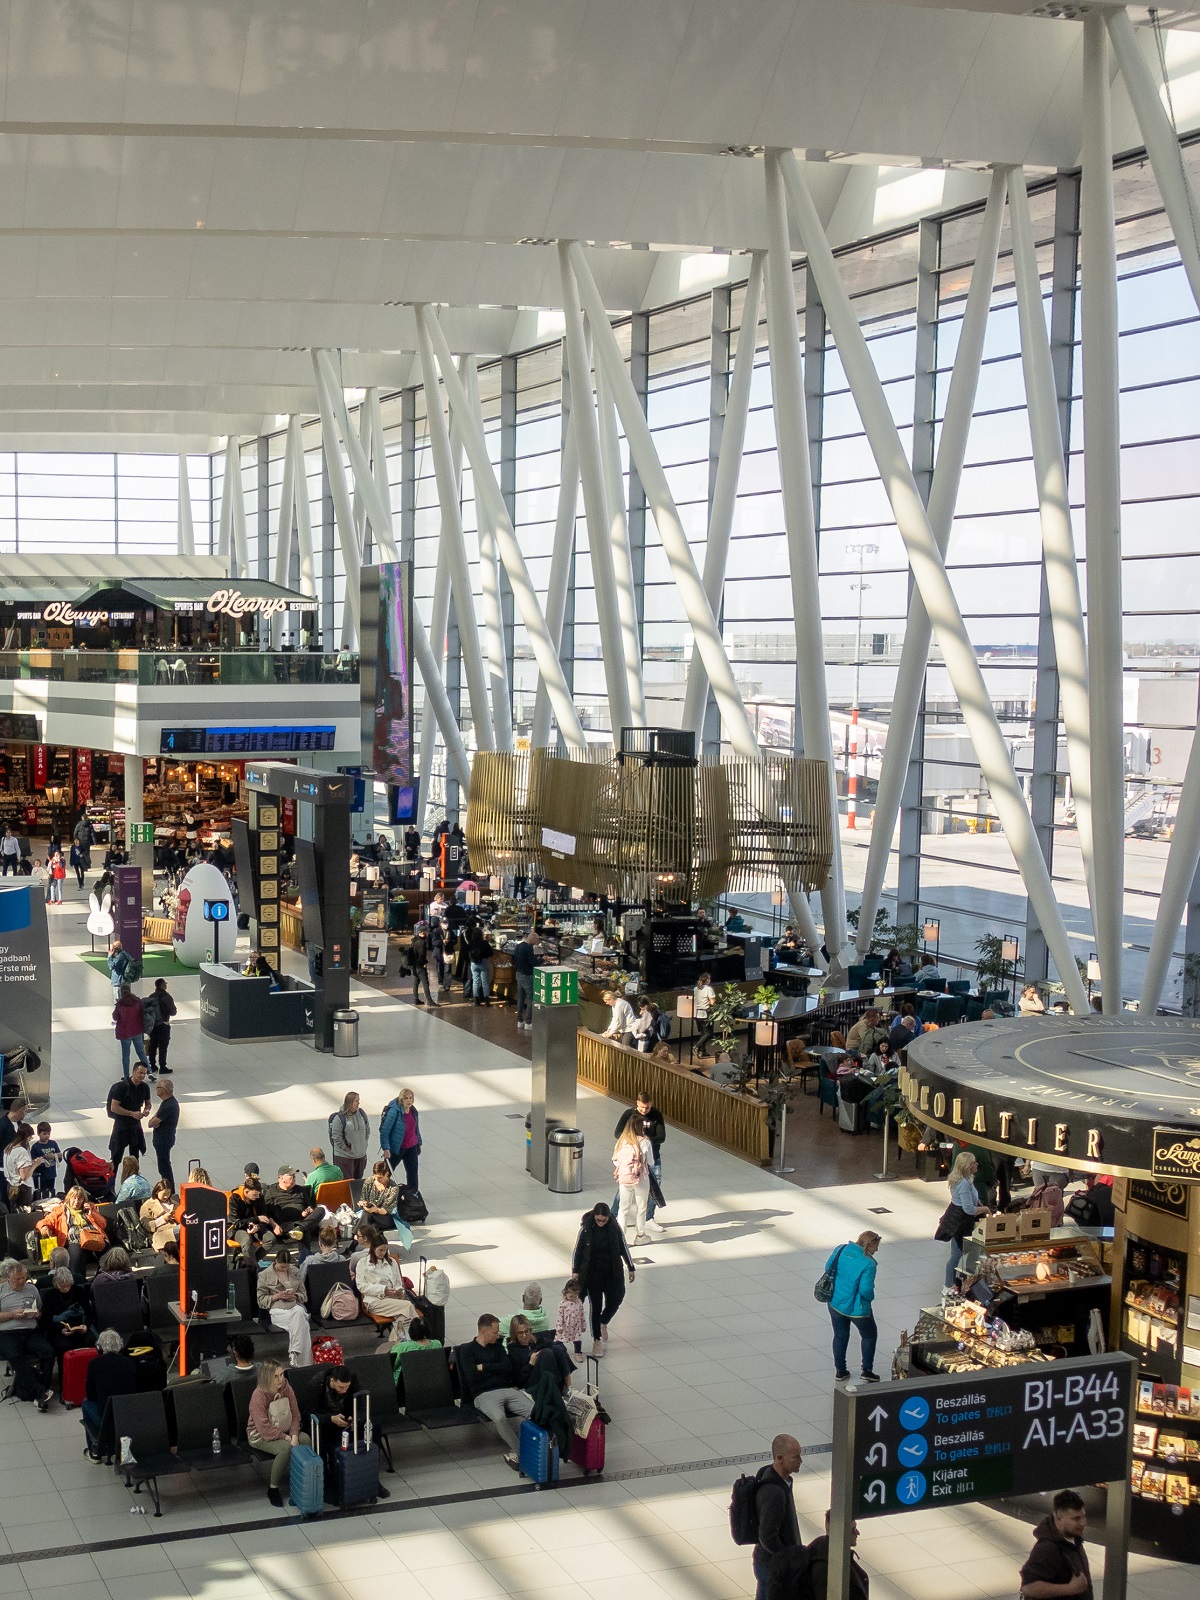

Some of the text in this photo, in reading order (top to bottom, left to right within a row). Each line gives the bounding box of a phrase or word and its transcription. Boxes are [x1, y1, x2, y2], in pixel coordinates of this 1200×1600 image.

[174, 602, 204, 611] SPORTS BAR
[206, 589, 287, 620] O'Learys
[290, 602, 318, 611] RESTAURANT
[1152, 747, 1161, 765] 3
[293, 779, 299, 793] A
[21, 963, 37, 972] már
[4, 973, 37, 982] benned.
[186, 1217, 198, 1225] bud
[1024, 1371, 1119, 1412] B1-B44
[935, 1393, 986, 1409] Beszállás
[935, 1410, 981, 1424] To gates
[1022, 1407, 1125, 1450] A1-A33
[934, 1430, 984, 1446] Beszállás
[934, 1447, 979, 1461] To gates
[932, 1467, 968, 1482] Kijárat
[932, 1483, 952, 1496] Exit
